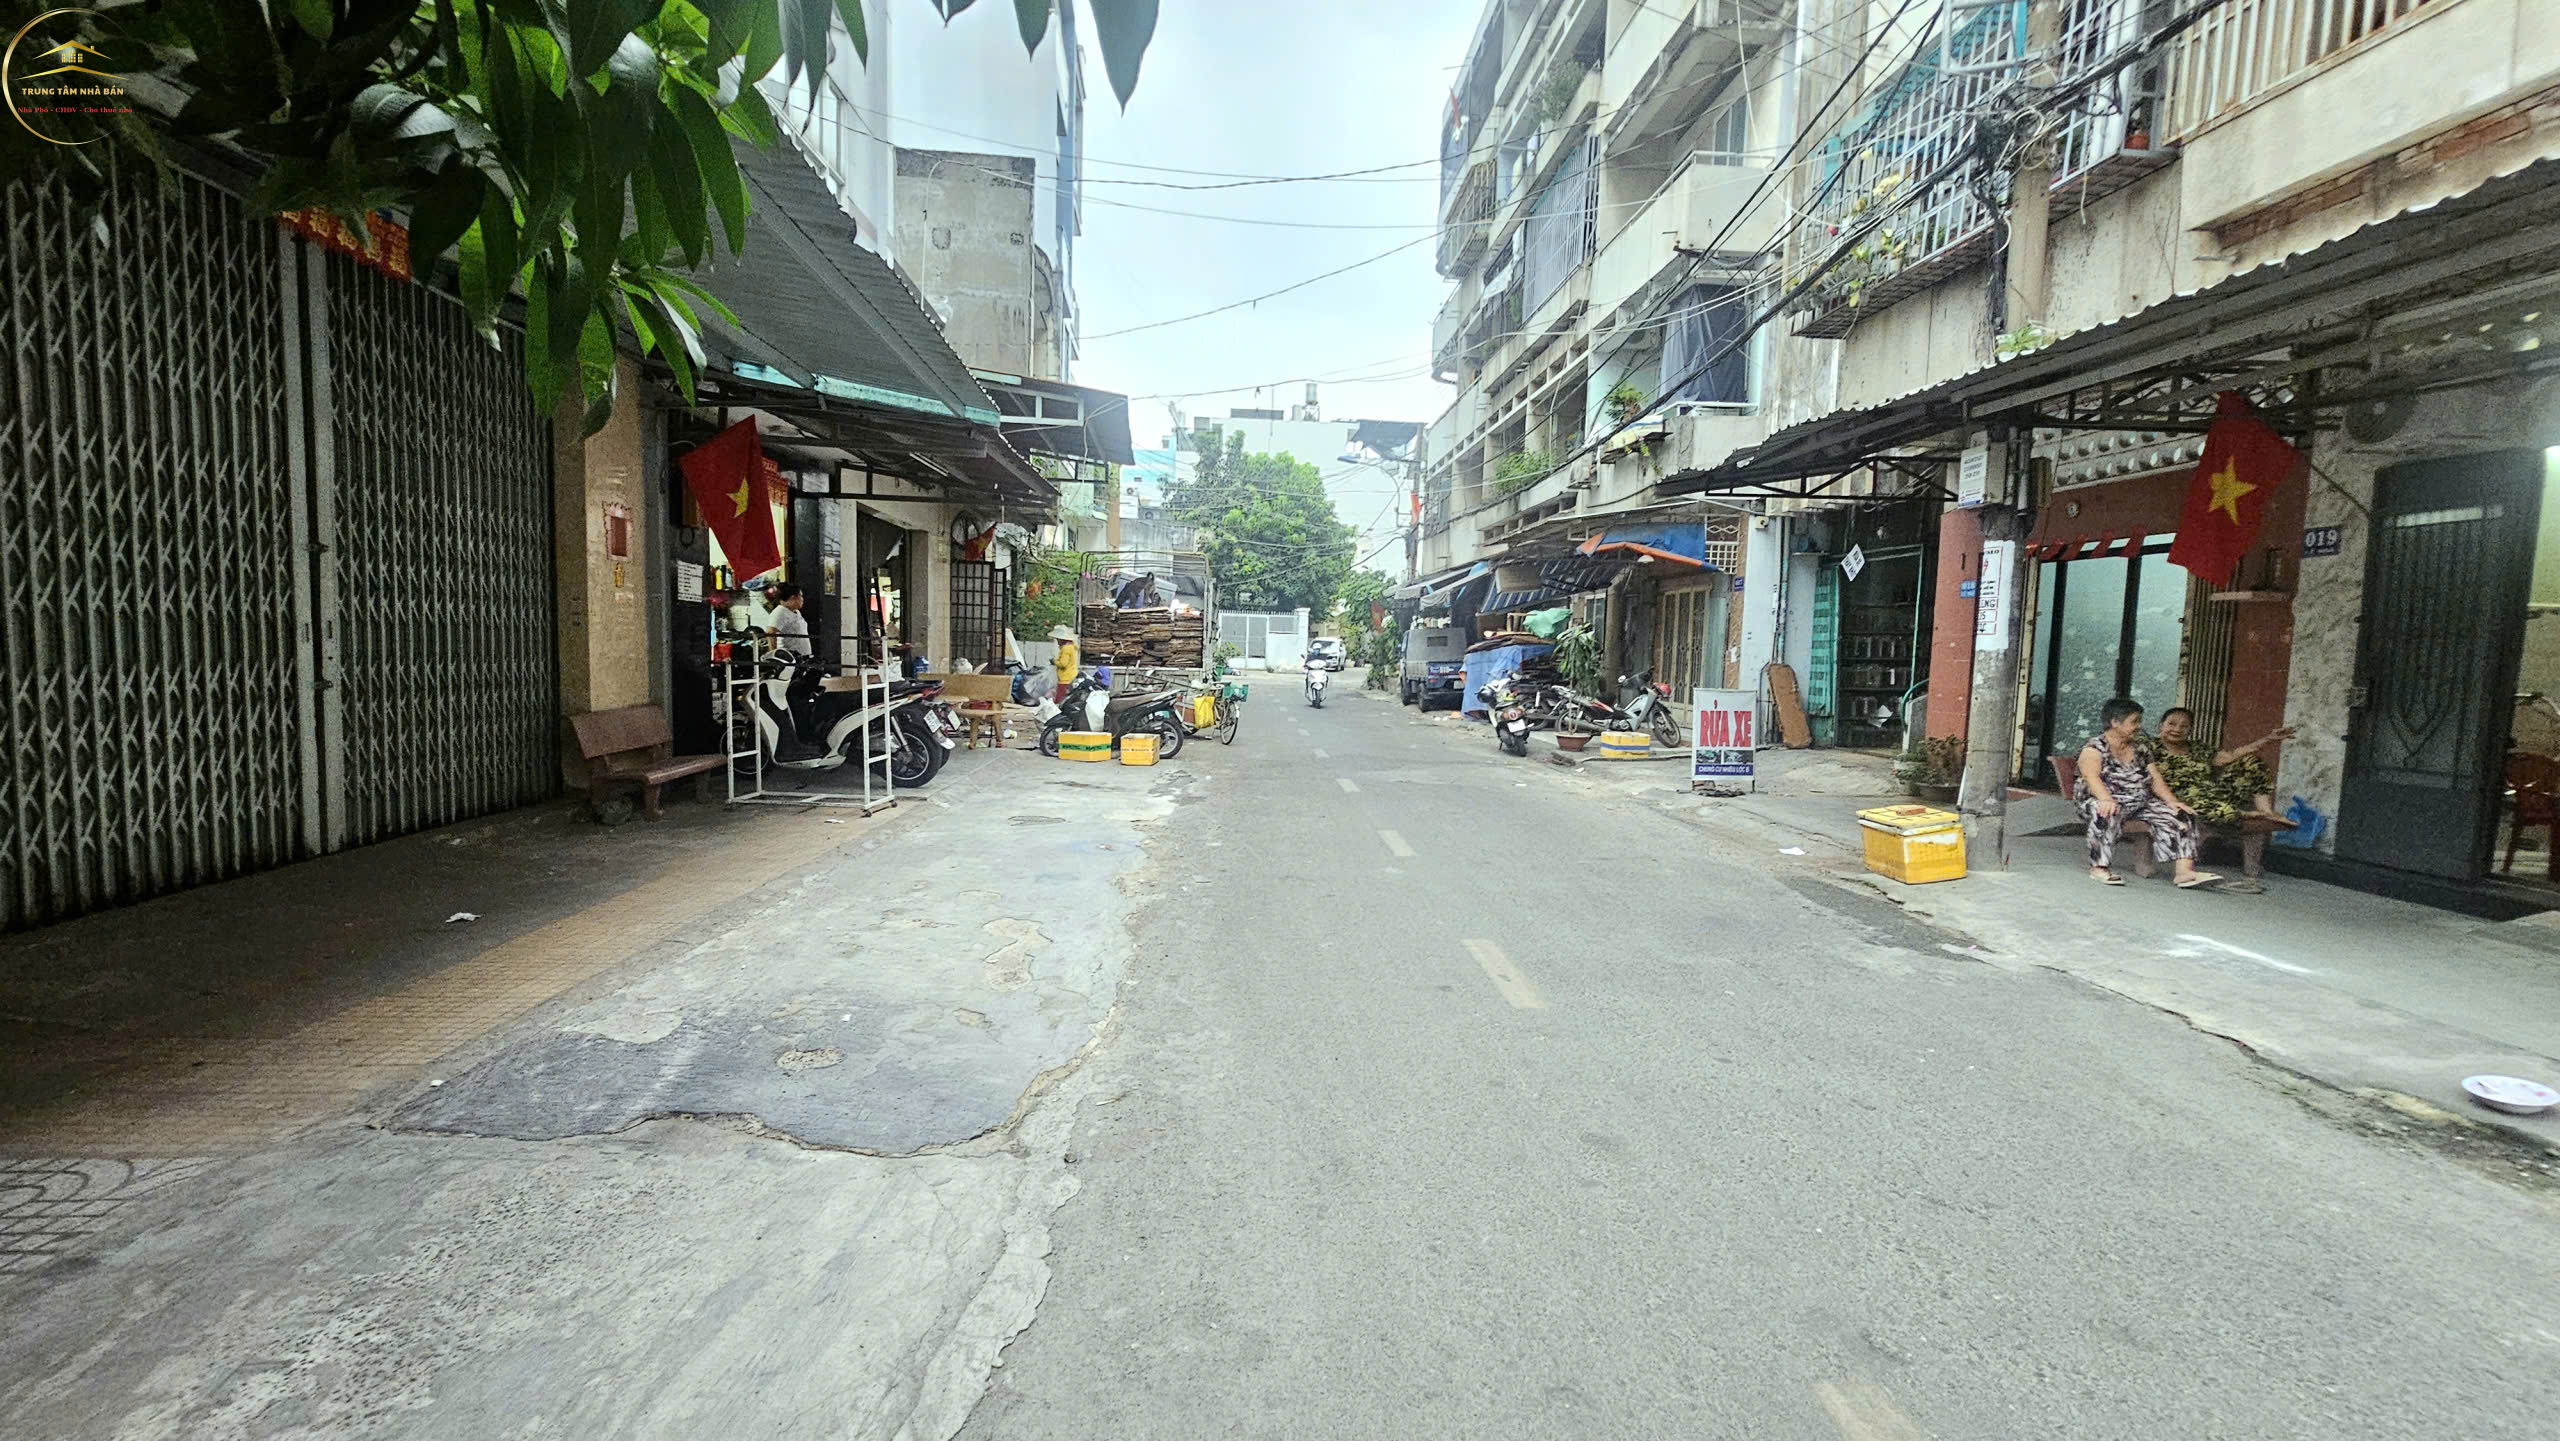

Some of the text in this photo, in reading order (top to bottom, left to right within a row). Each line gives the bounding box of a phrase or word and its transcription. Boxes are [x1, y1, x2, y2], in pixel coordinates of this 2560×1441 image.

[2305, 529, 2338, 547] 019
[1699, 699, 1752, 748] RỬA XE
